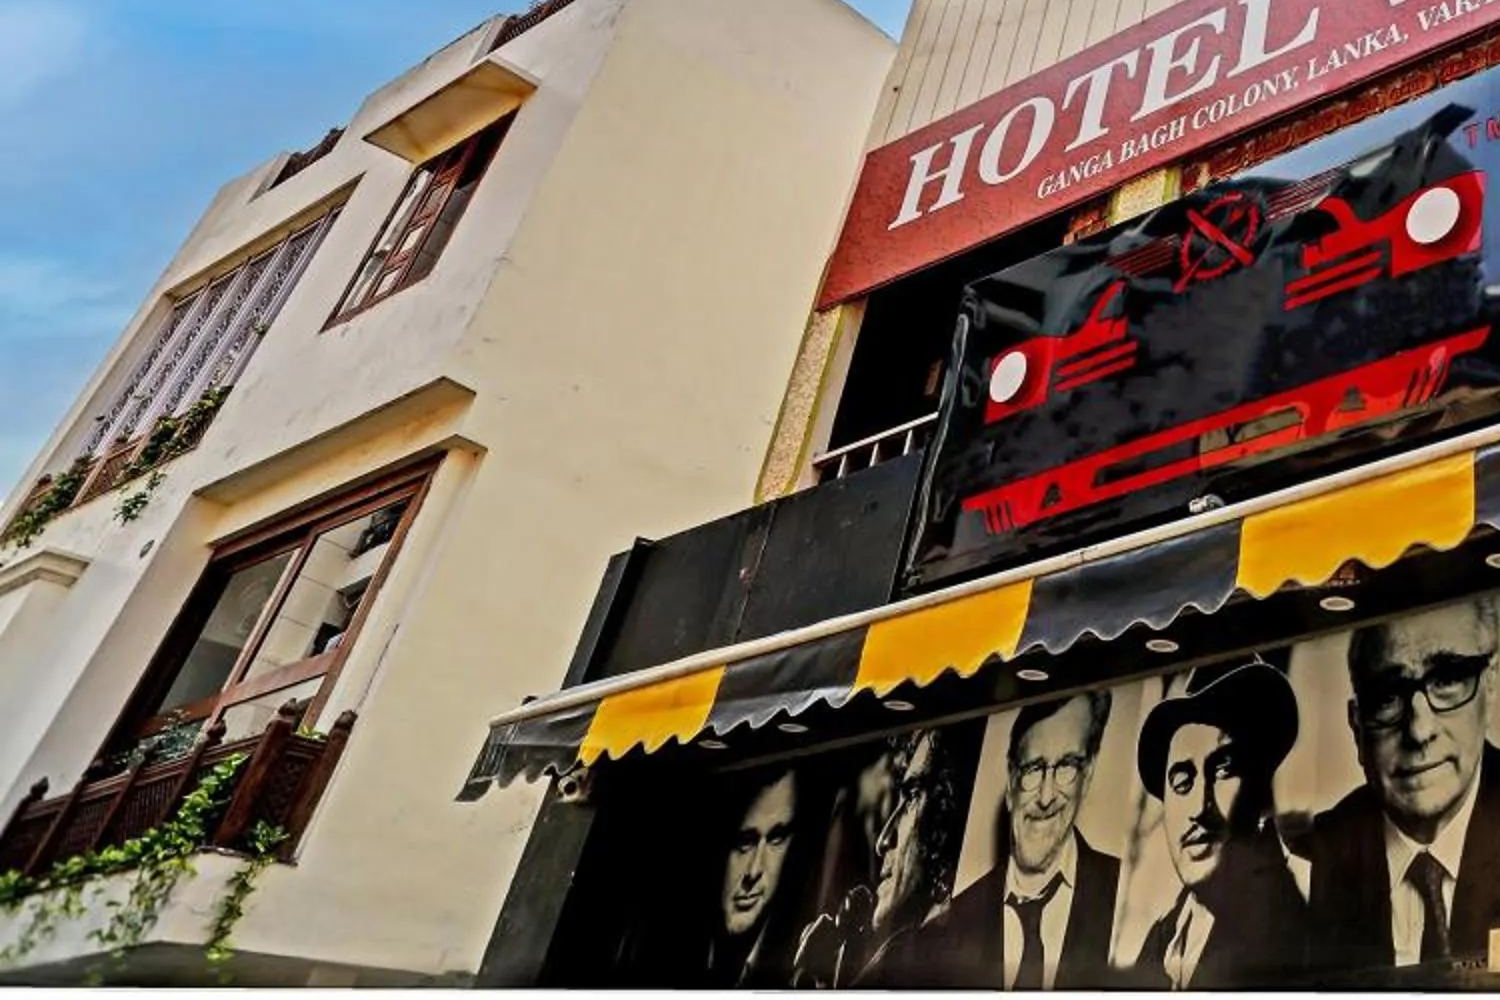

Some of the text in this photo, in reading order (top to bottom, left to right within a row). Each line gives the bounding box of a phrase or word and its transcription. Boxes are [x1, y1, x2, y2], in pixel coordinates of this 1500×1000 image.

[1037, 155, 1113, 199] GANGA
[1119, 114, 1187, 164] BAGH
[1191, 65, 1300, 130] COLONY,
[1306, 23, 1410, 82] LANKA,
